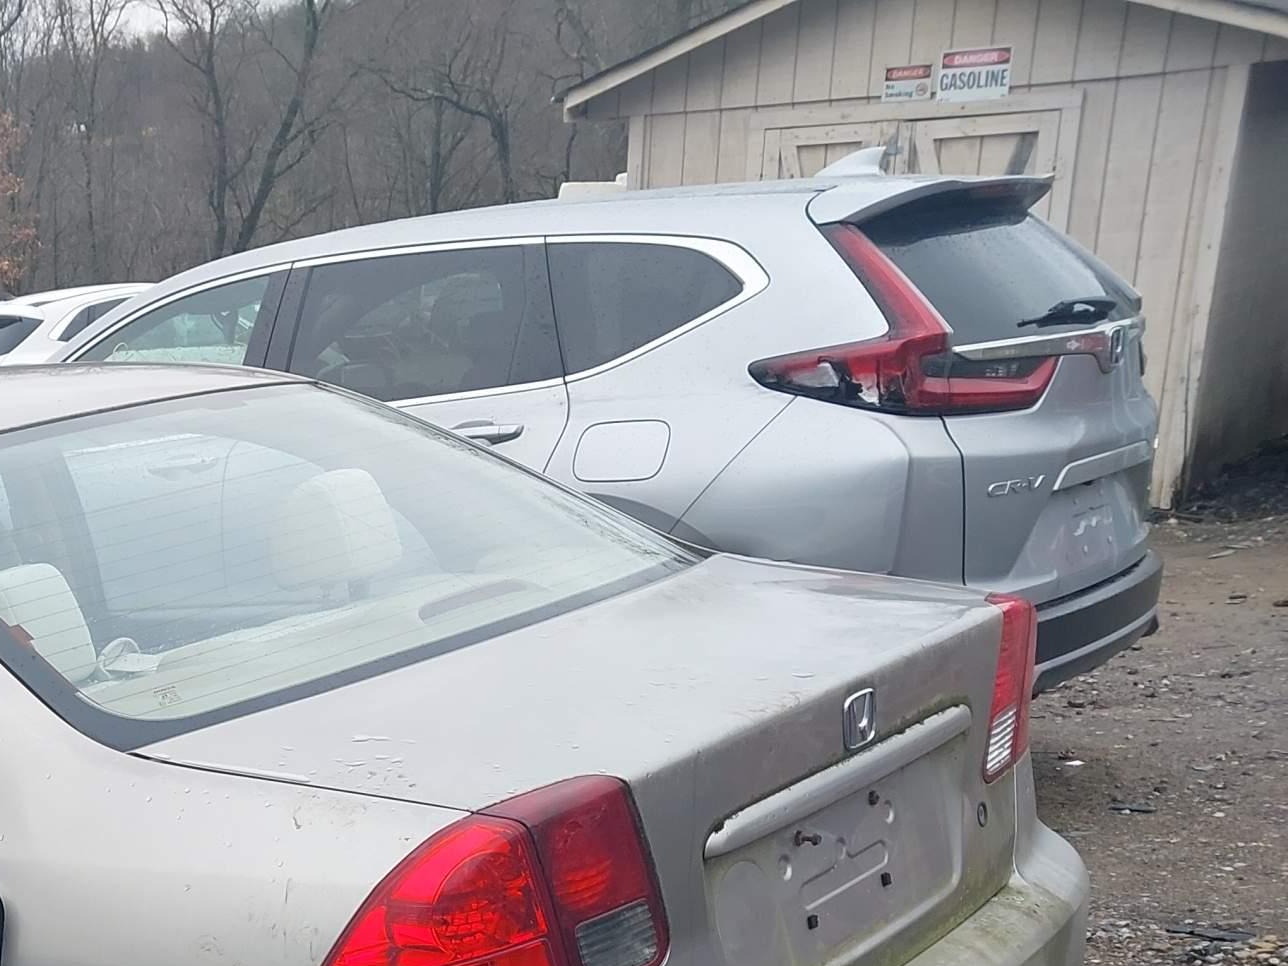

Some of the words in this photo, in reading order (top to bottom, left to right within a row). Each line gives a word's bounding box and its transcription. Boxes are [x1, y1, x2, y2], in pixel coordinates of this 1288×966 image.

[953, 51, 999, 65] DANGER
[939, 69, 1009, 92] GASOLINE
[987, 474, 1046, 498] CR-V
